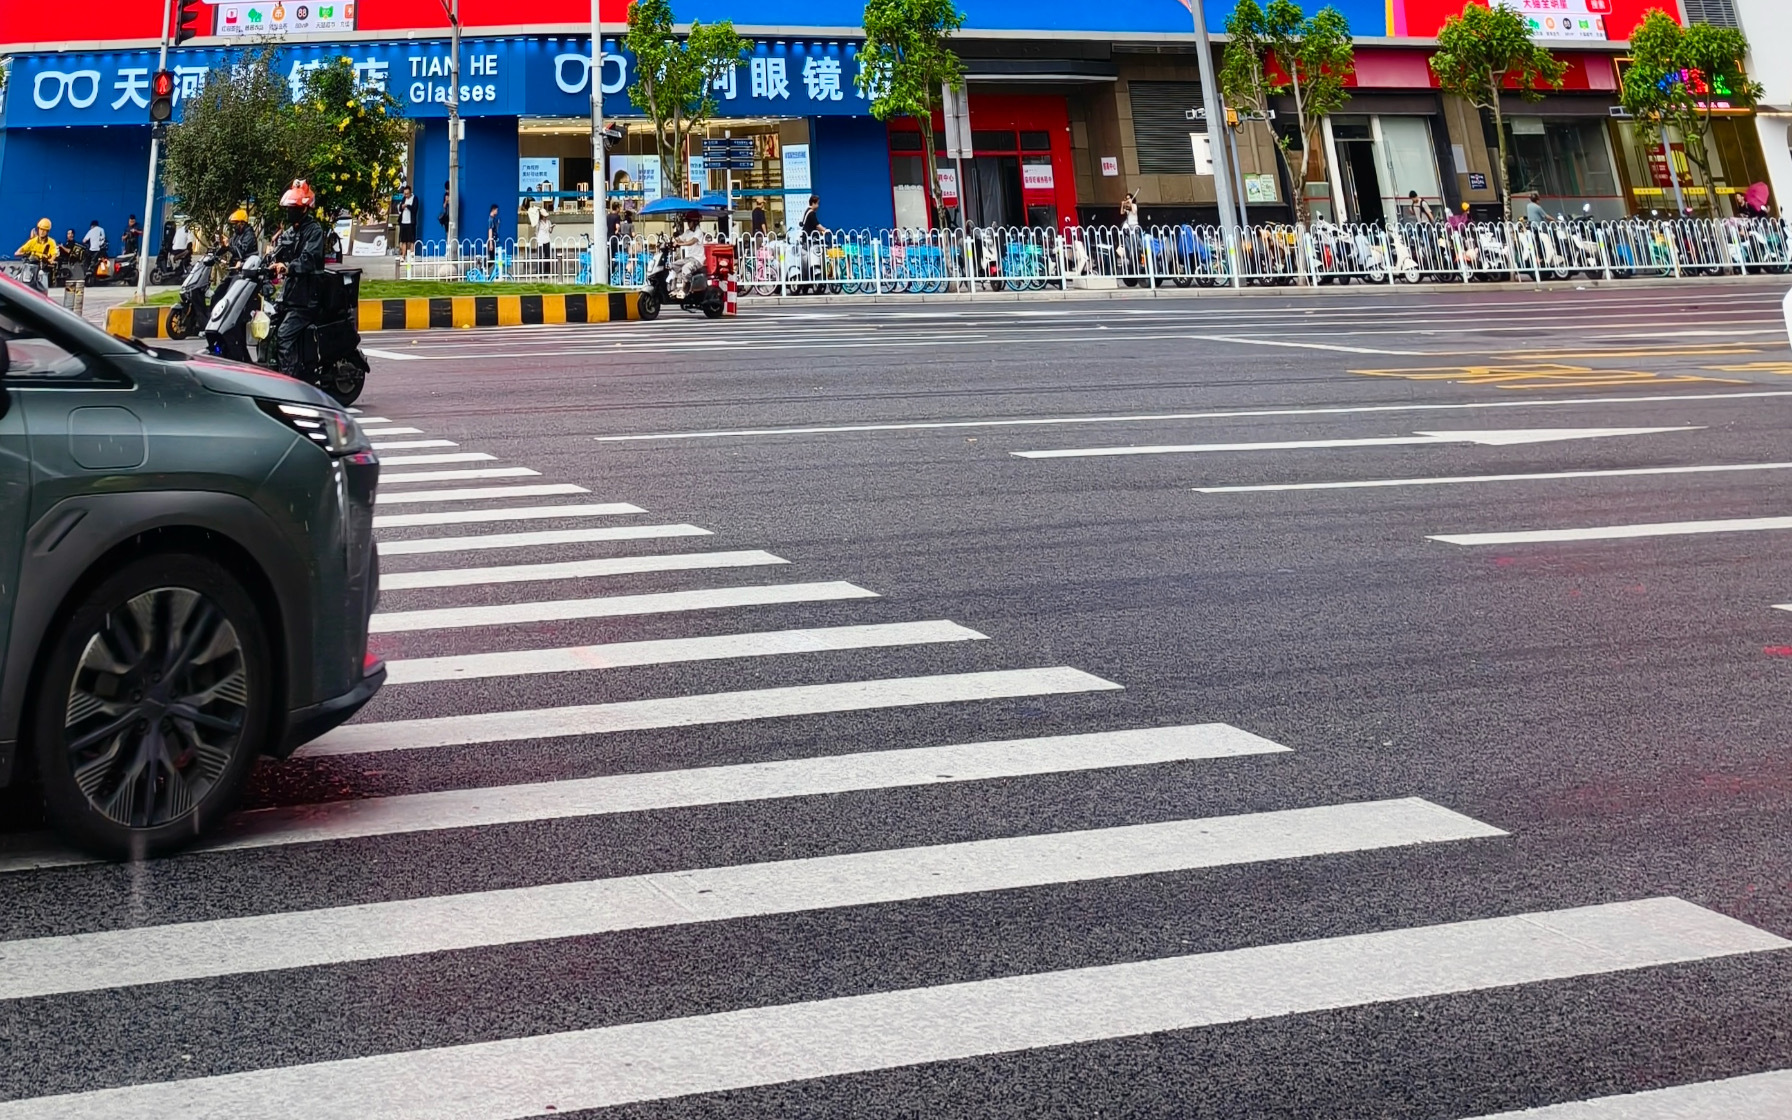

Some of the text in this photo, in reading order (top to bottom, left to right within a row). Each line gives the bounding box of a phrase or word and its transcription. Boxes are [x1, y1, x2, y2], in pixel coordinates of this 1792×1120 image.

[298, 8, 308, 19] 88
[408, 54, 499, 78] TIAN HE
